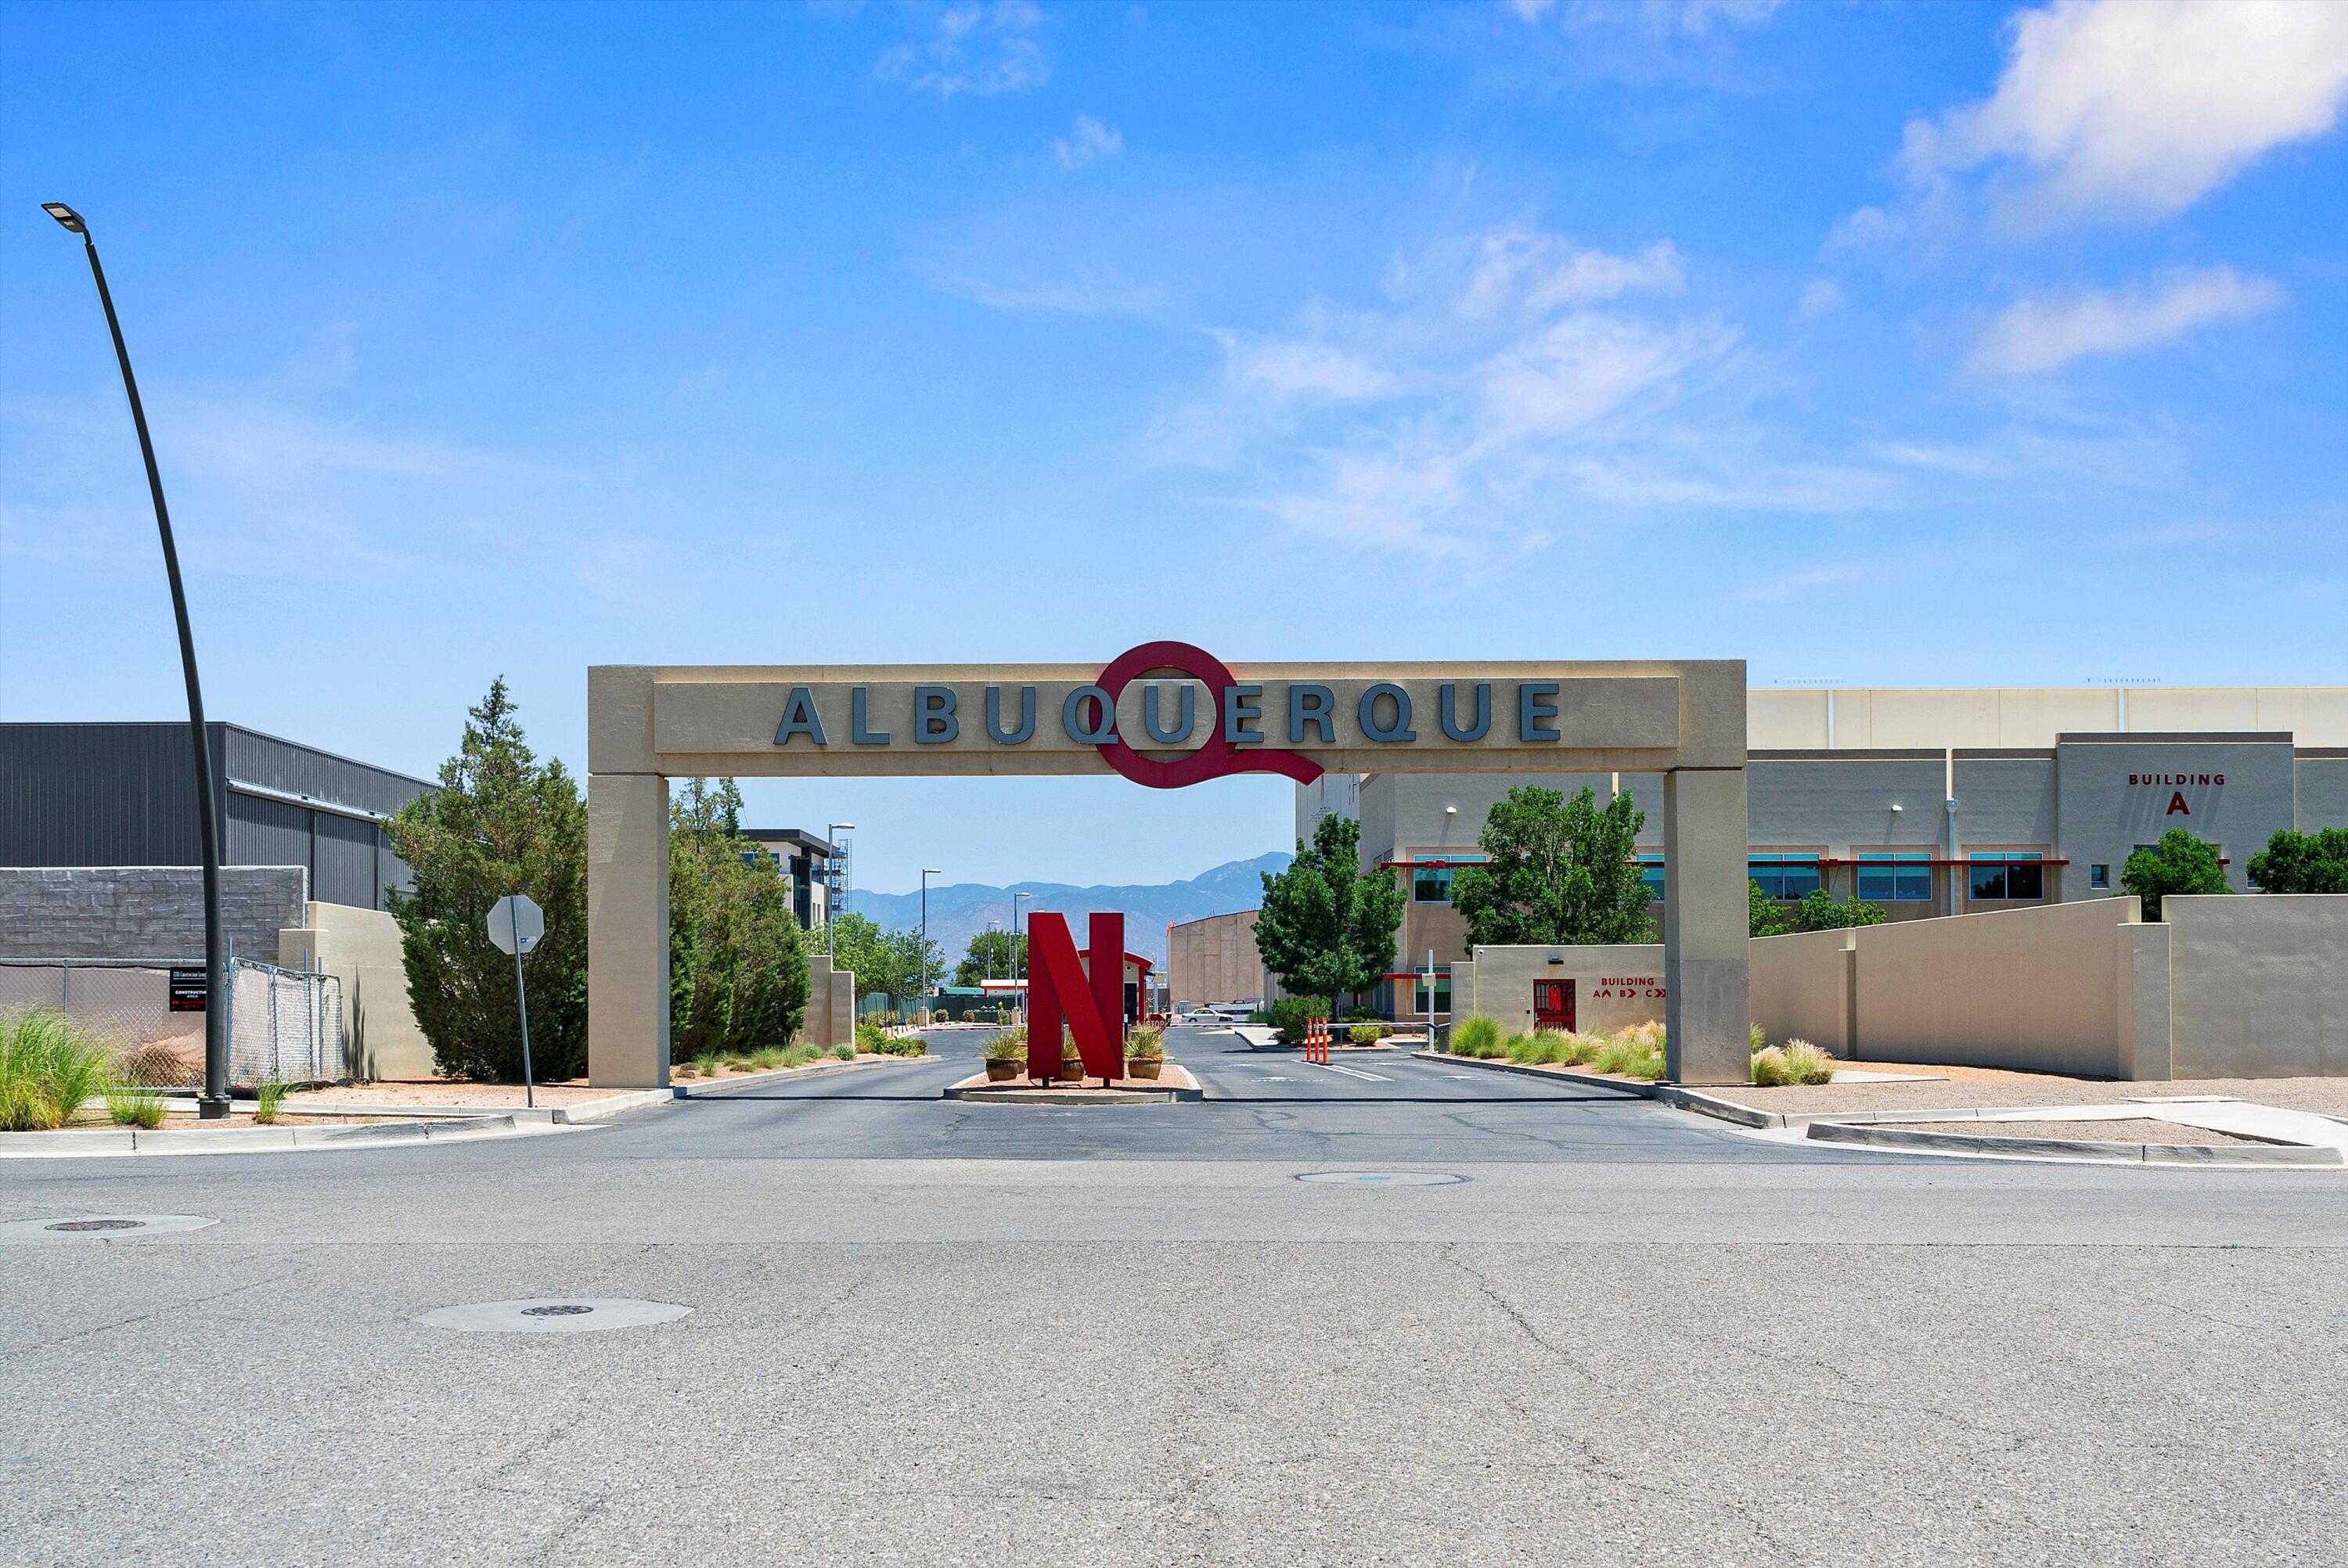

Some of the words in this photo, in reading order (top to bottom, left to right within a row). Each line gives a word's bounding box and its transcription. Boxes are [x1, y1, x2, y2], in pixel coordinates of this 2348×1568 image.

[772, 683, 1561, 744] ALBUQUERQUE
[2128, 773, 2226, 786] BUILDING
[2166, 791, 2191, 815] A
[1601, 977, 1655, 986] BUILDING
[1028, 912, 1125, 1081] N
[1593, 989, 1601, 998] A
[1619, 989, 1626, 998] B
[1645, 989, 1653, 998] C
[1146, 1020, 1165, 1028] STOP
